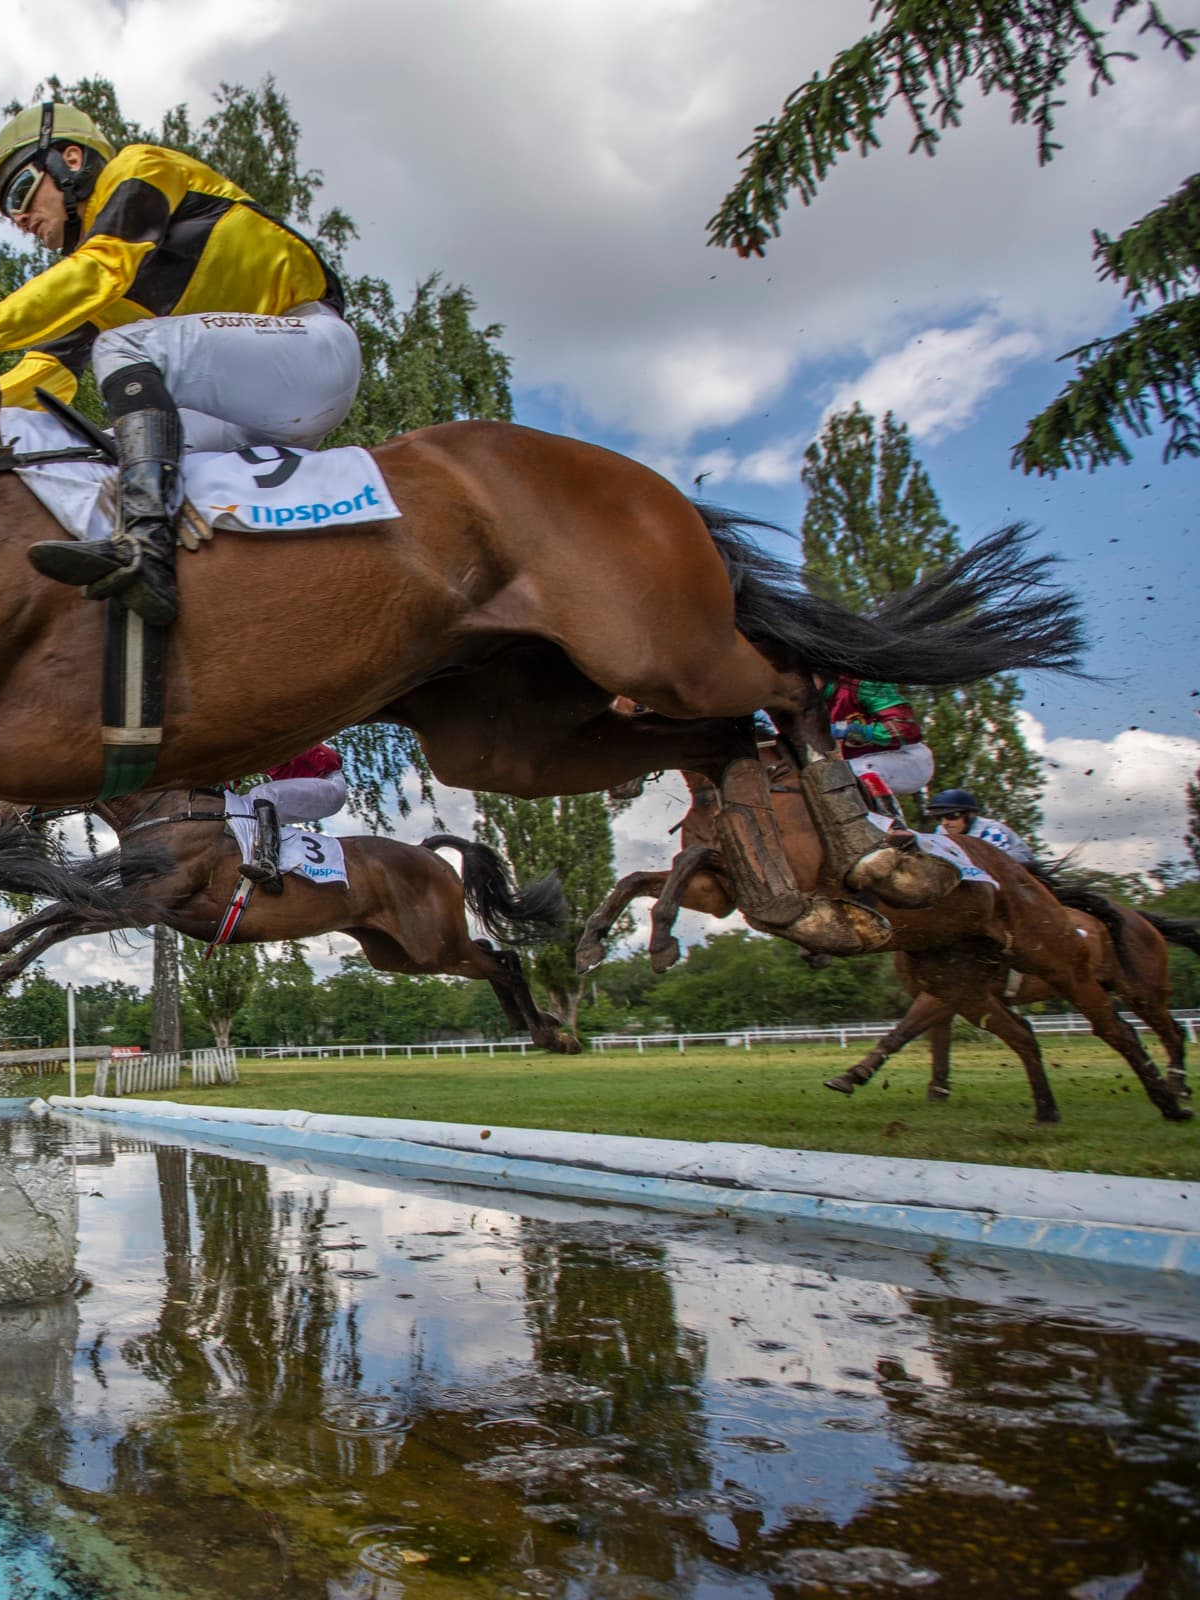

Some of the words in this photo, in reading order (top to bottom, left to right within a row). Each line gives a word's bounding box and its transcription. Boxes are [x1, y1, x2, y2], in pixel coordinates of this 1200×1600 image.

[237, 446, 303, 488] 9
[251, 484, 380, 527] Tipsport
[301, 836, 325, 864] 3
